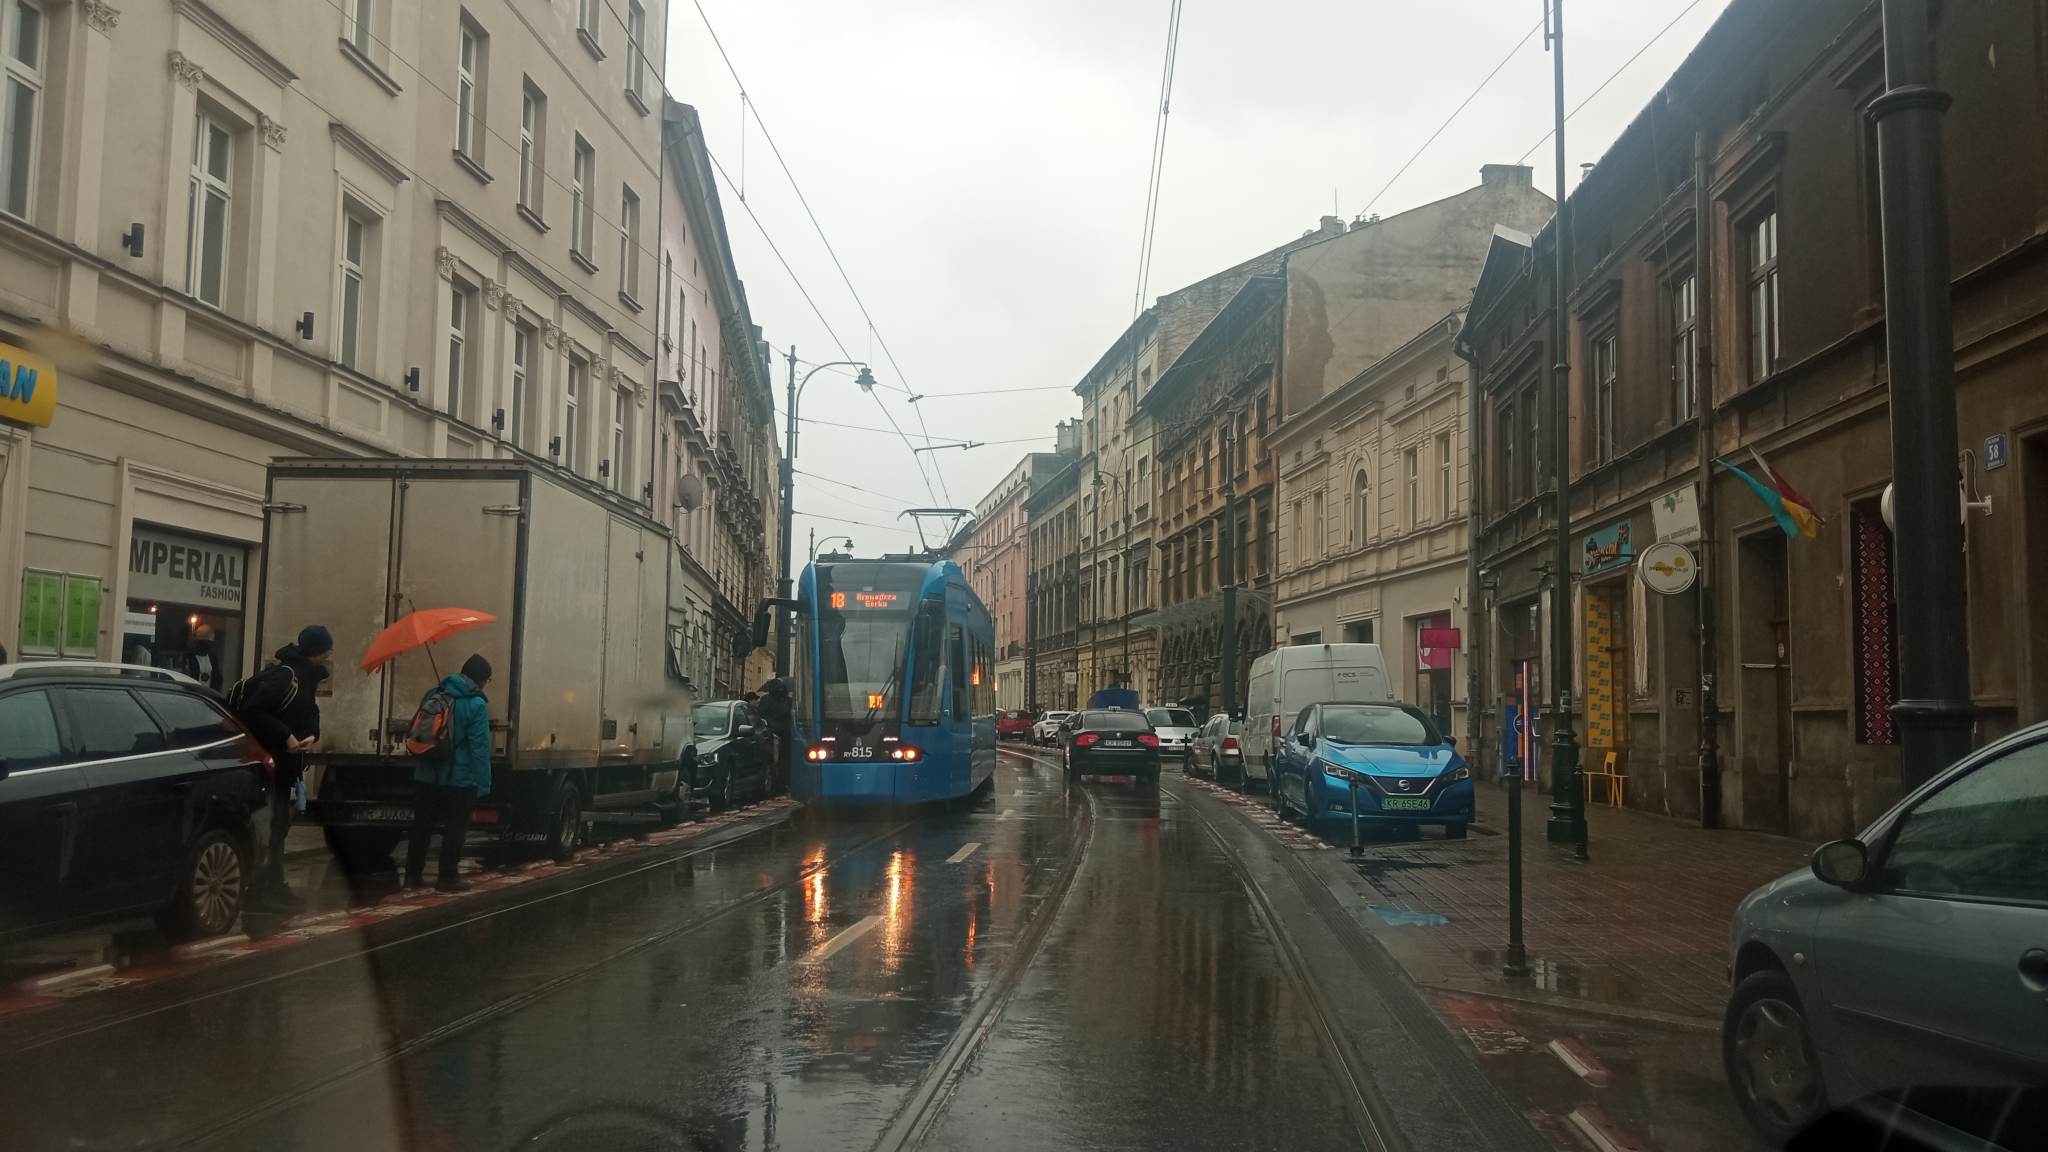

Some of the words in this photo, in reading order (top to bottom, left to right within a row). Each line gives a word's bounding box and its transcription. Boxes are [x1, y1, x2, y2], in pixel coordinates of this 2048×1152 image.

[1988, 444, 1999, 460] 58
[200, 585, 241, 603] FASHION
[830, 592, 846, 608] 18
[1386, 799, 1399, 808] KR
